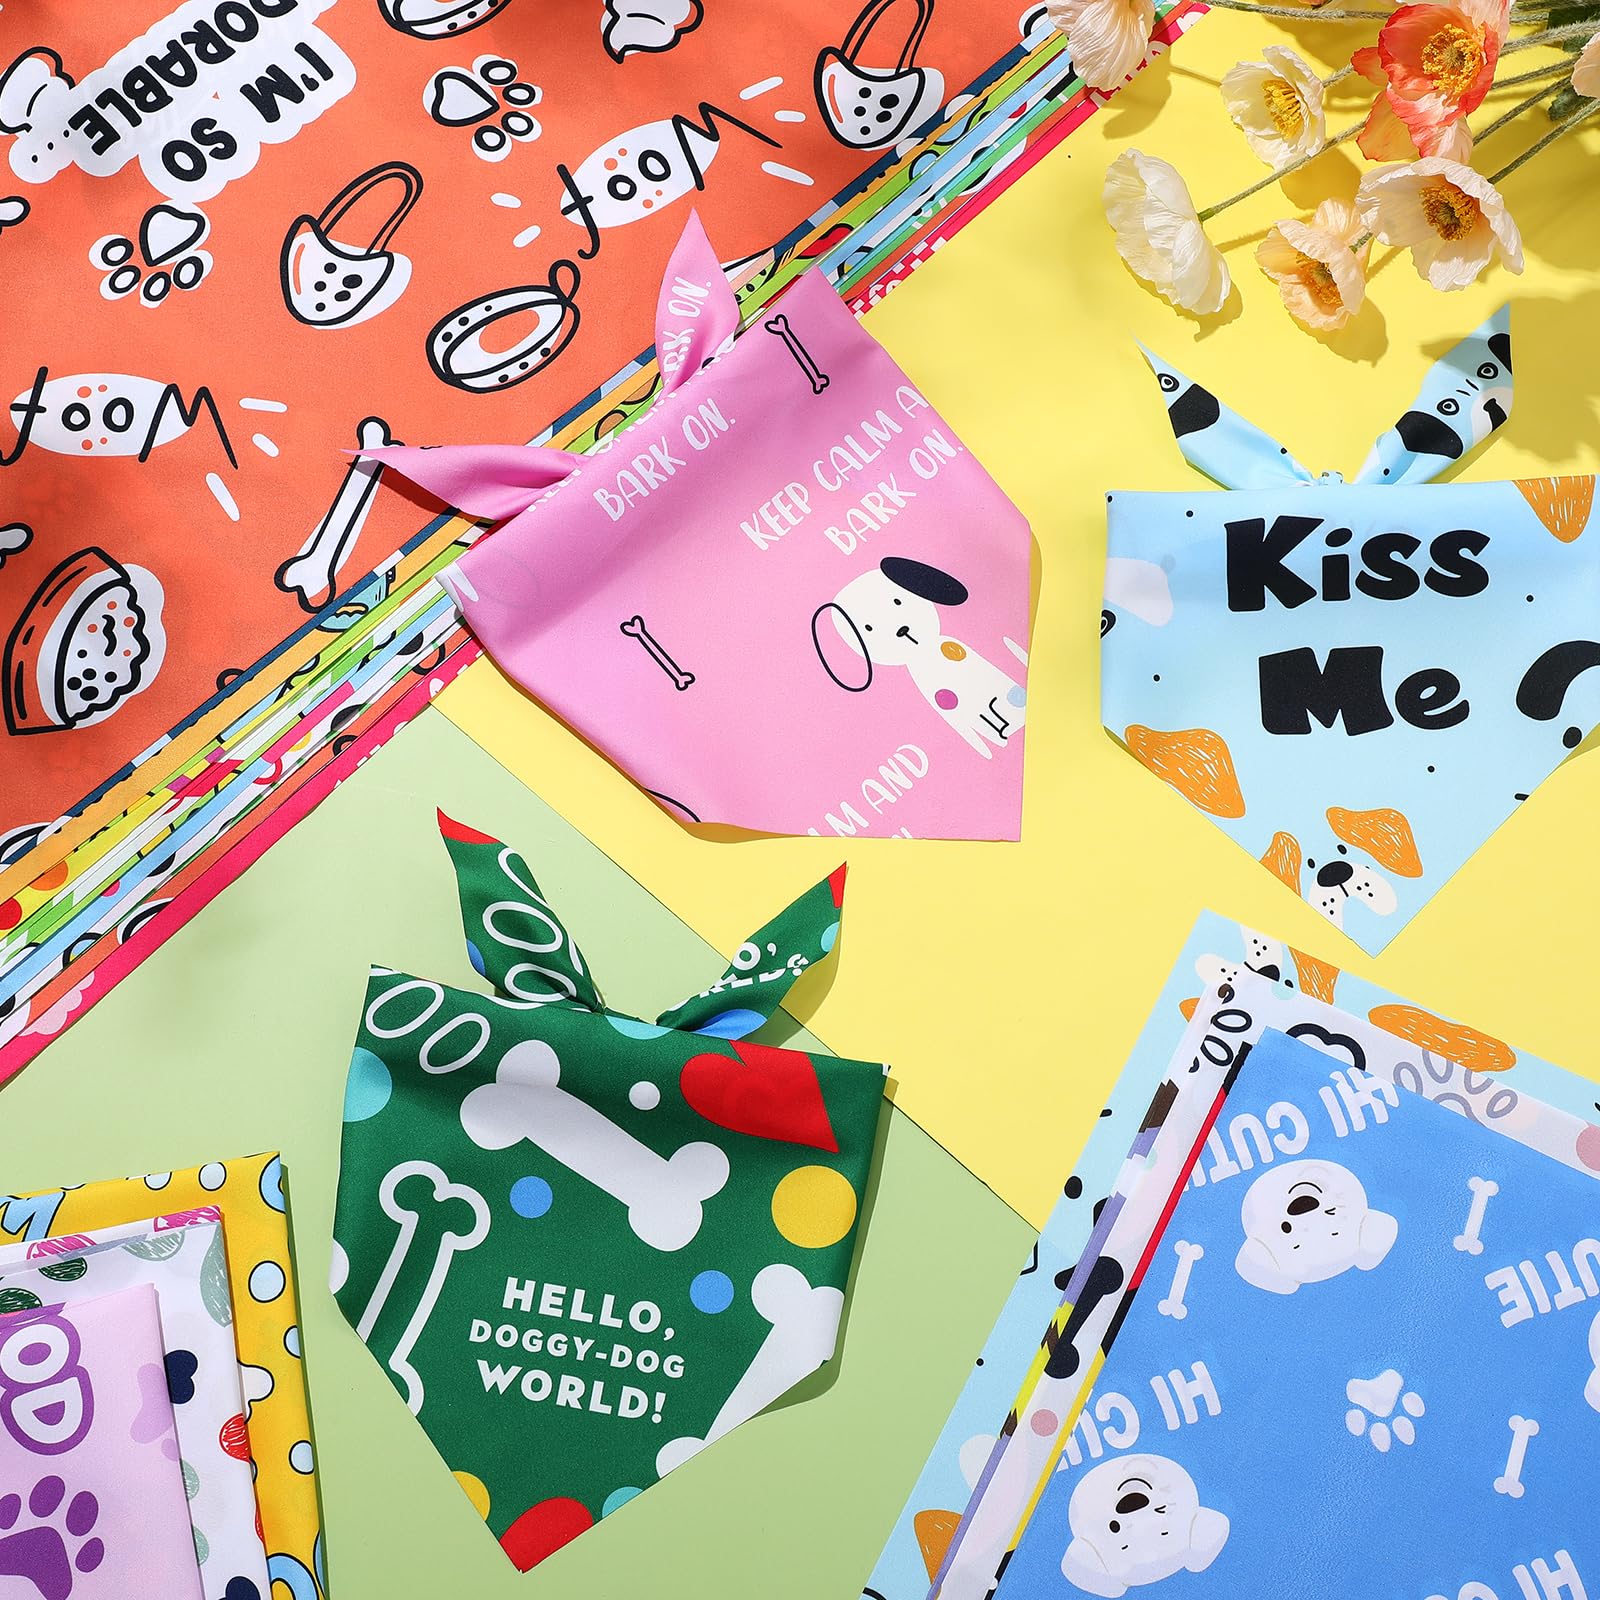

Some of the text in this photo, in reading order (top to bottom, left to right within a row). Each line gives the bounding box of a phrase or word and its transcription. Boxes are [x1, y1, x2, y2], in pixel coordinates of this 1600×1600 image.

[161, 41, 334, 182] I'M SO
[592, 435, 688, 523] BARK
[681, 397, 737, 451] ON.
[739, 481, 812, 551] KEEP
[812, 409, 903, 492] CALM
[823, 428, 964, 556] BARK ON.
[1223, 515, 1491, 612] Kiss
[1258, 645, 1470, 736] Me
[861, 743, 929, 815] AND
[468, 1318, 685, 1379] DOGGY-DOG
[501, 1276, 675, 1341] HELLO,
[476, 1359, 667, 1424] WORLD!
[1149, 1360, 1222, 1431] HI
